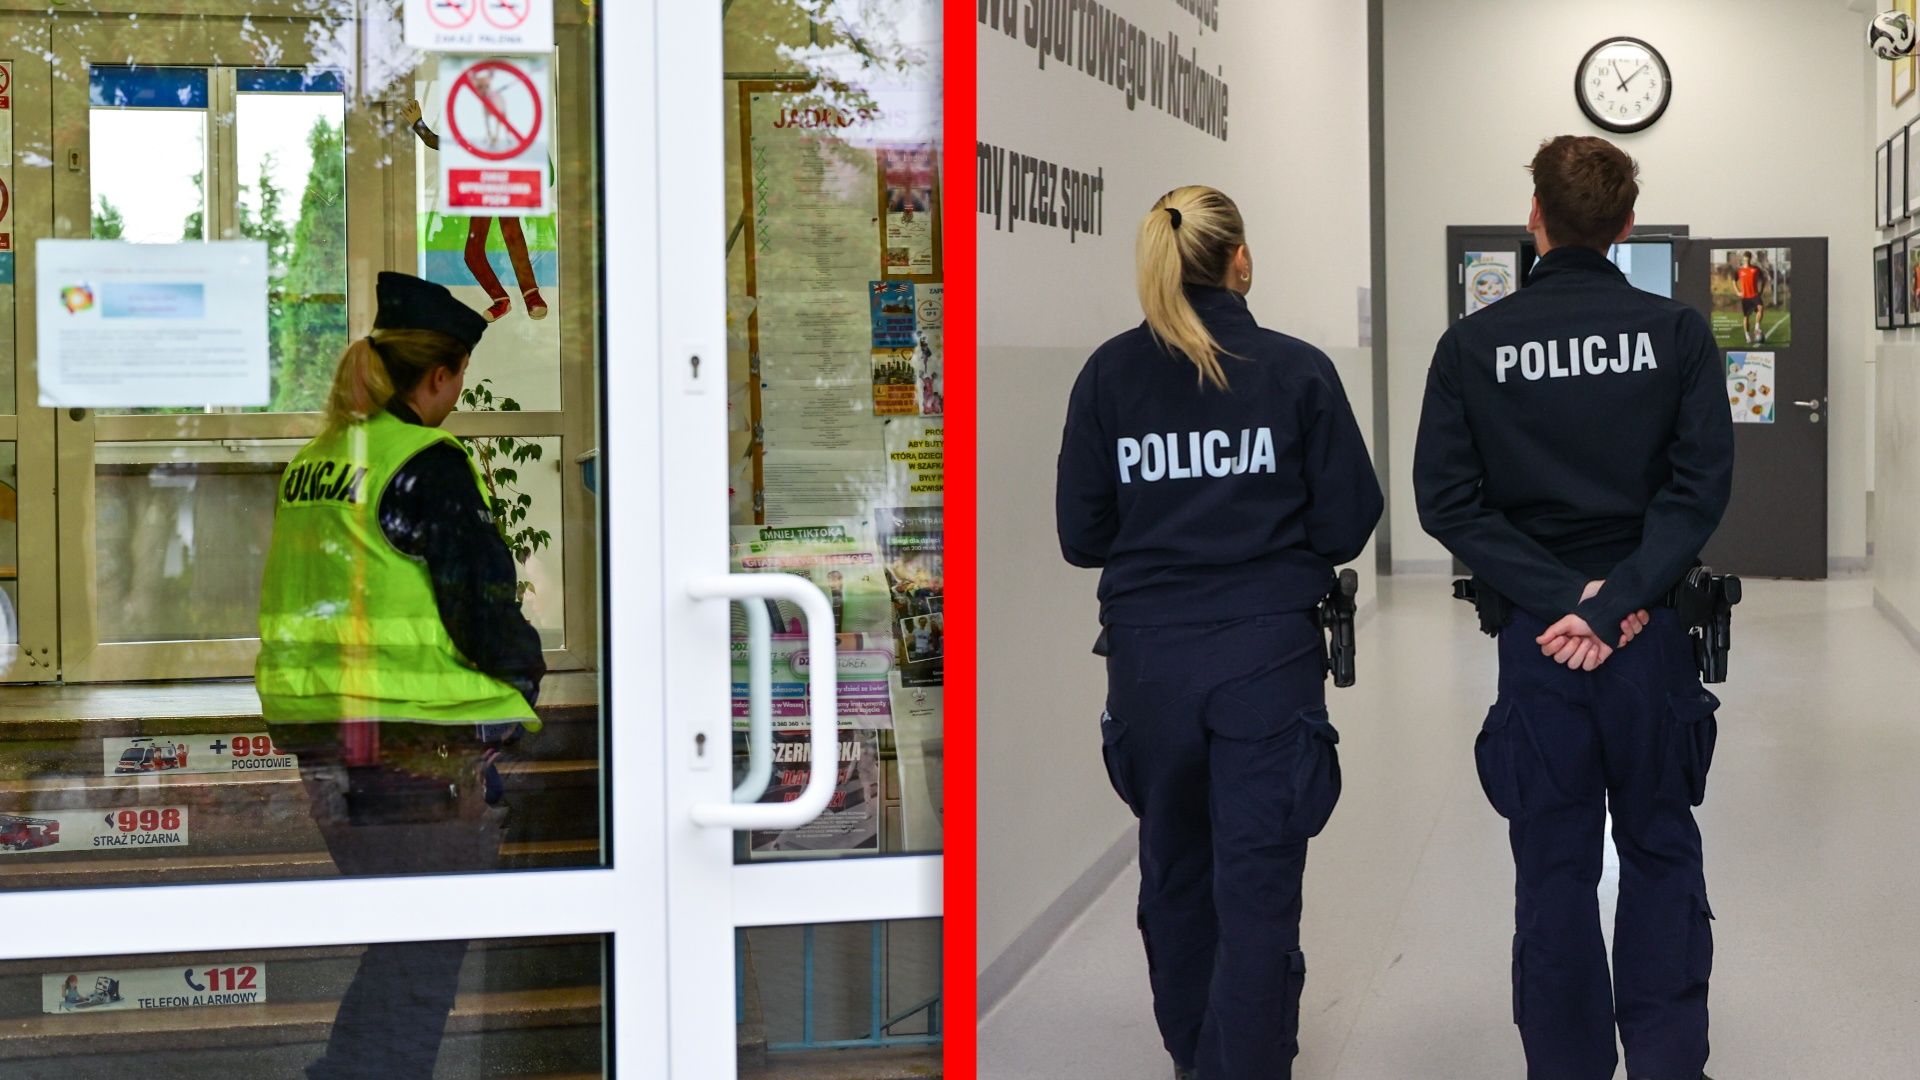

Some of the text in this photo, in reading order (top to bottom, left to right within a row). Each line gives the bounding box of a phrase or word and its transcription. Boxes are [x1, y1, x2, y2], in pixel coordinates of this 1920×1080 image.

[1150, 36, 1165, 110] w
[1167, 31, 1229, 142] Krakowie
[1009, 150, 1058, 233] przez
[1061, 166, 1103, 244] sport
[1495, 332, 1658, 383] POLICJA
[890, 452, 917, 461] KTÓRĄ
[1117, 427, 1277, 484] POLICJA
[284, 461, 368, 504] OLICJA
[763, 526, 844, 540] MNIEJ TIKTOKA
[231, 735, 287, 757] 99
[231, 757, 292, 770] POGOTOWIE
[118, 808, 181, 832] 998
[93, 831, 180, 847] STRAŻ POŻARNA
[204, 966, 257, 991] 112
[138, 992, 257, 1009] TELEFON ALARMOWY
